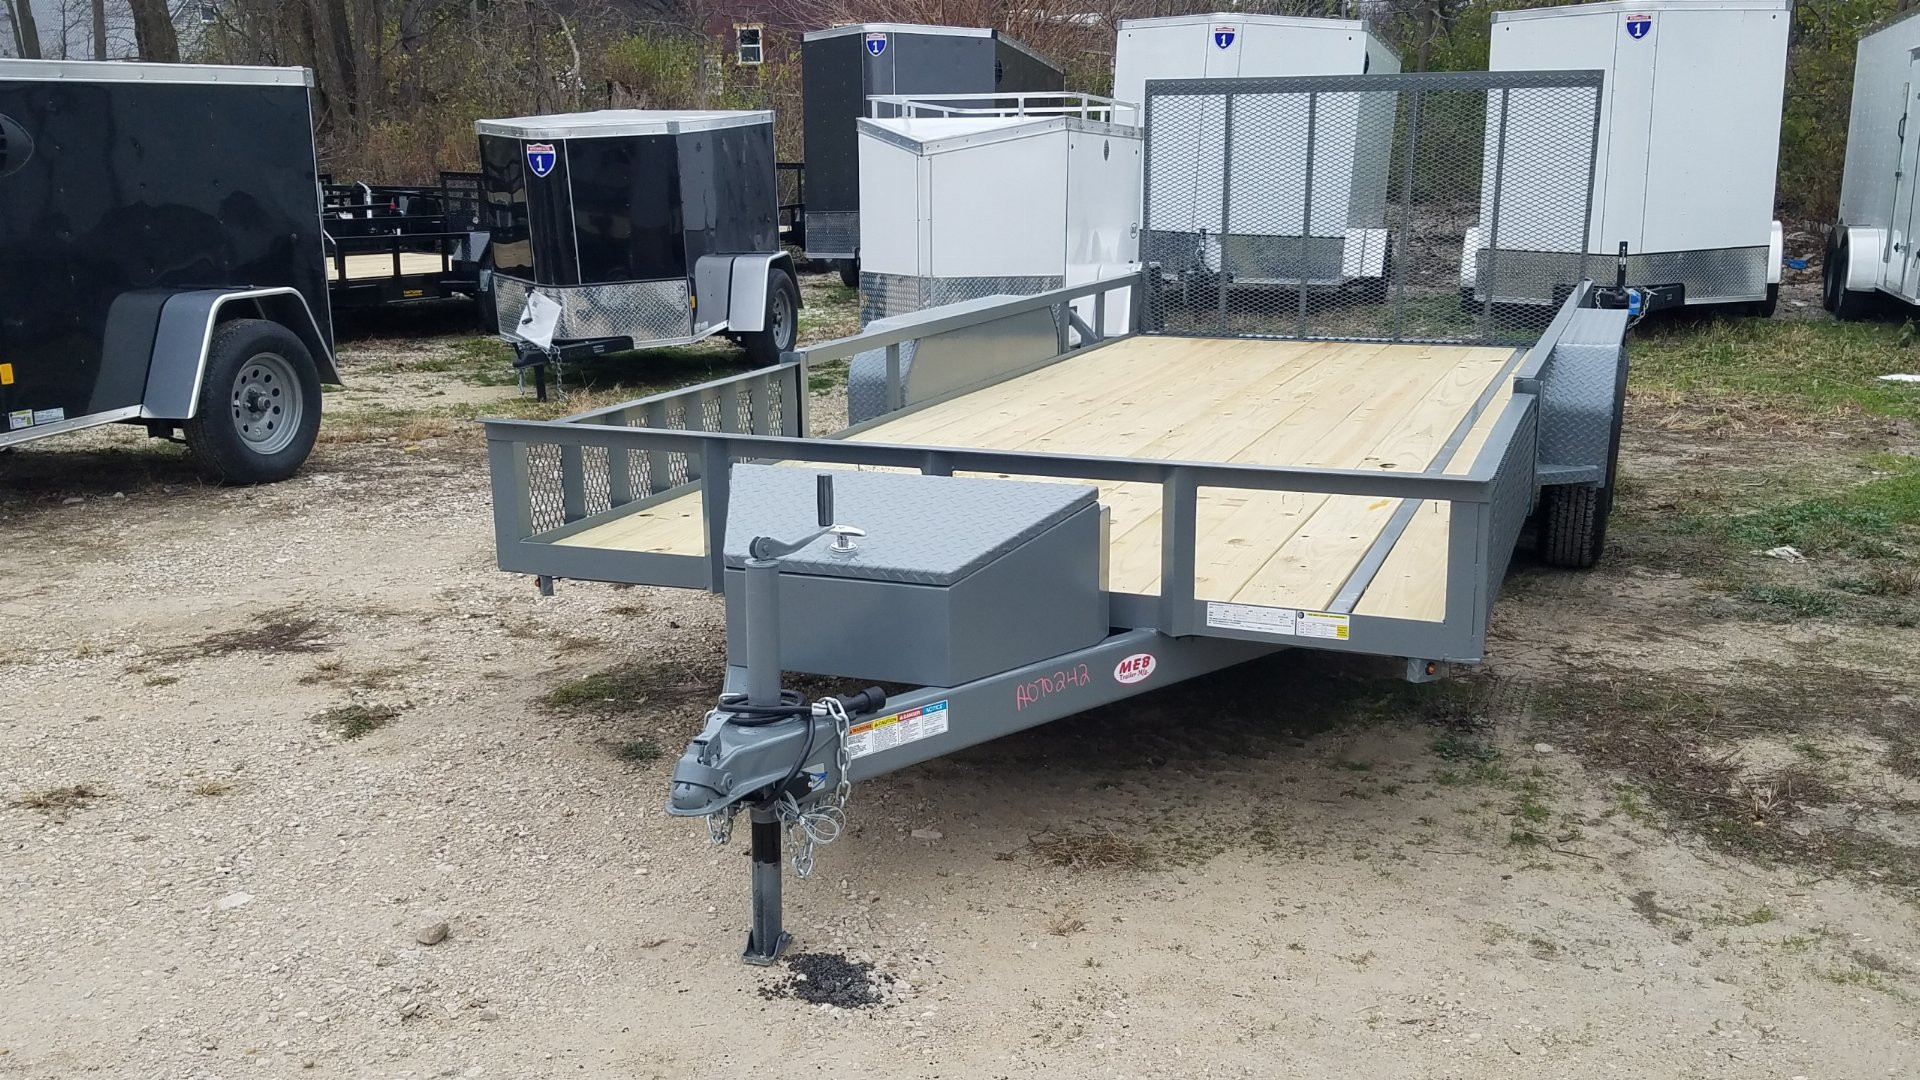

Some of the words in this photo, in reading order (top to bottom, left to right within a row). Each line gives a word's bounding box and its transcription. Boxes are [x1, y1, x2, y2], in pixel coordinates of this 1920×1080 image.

[1634, 22, 1642, 37] 1
[872, 40, 879, 53] 1
[1220, 33, 1227, 47] 1
[536, 154, 545, 172] 1
[926, 703, 943, 712] NOTICE
[903, 710, 921, 719] DANGER
[878, 717, 897, 726] CAUTION
